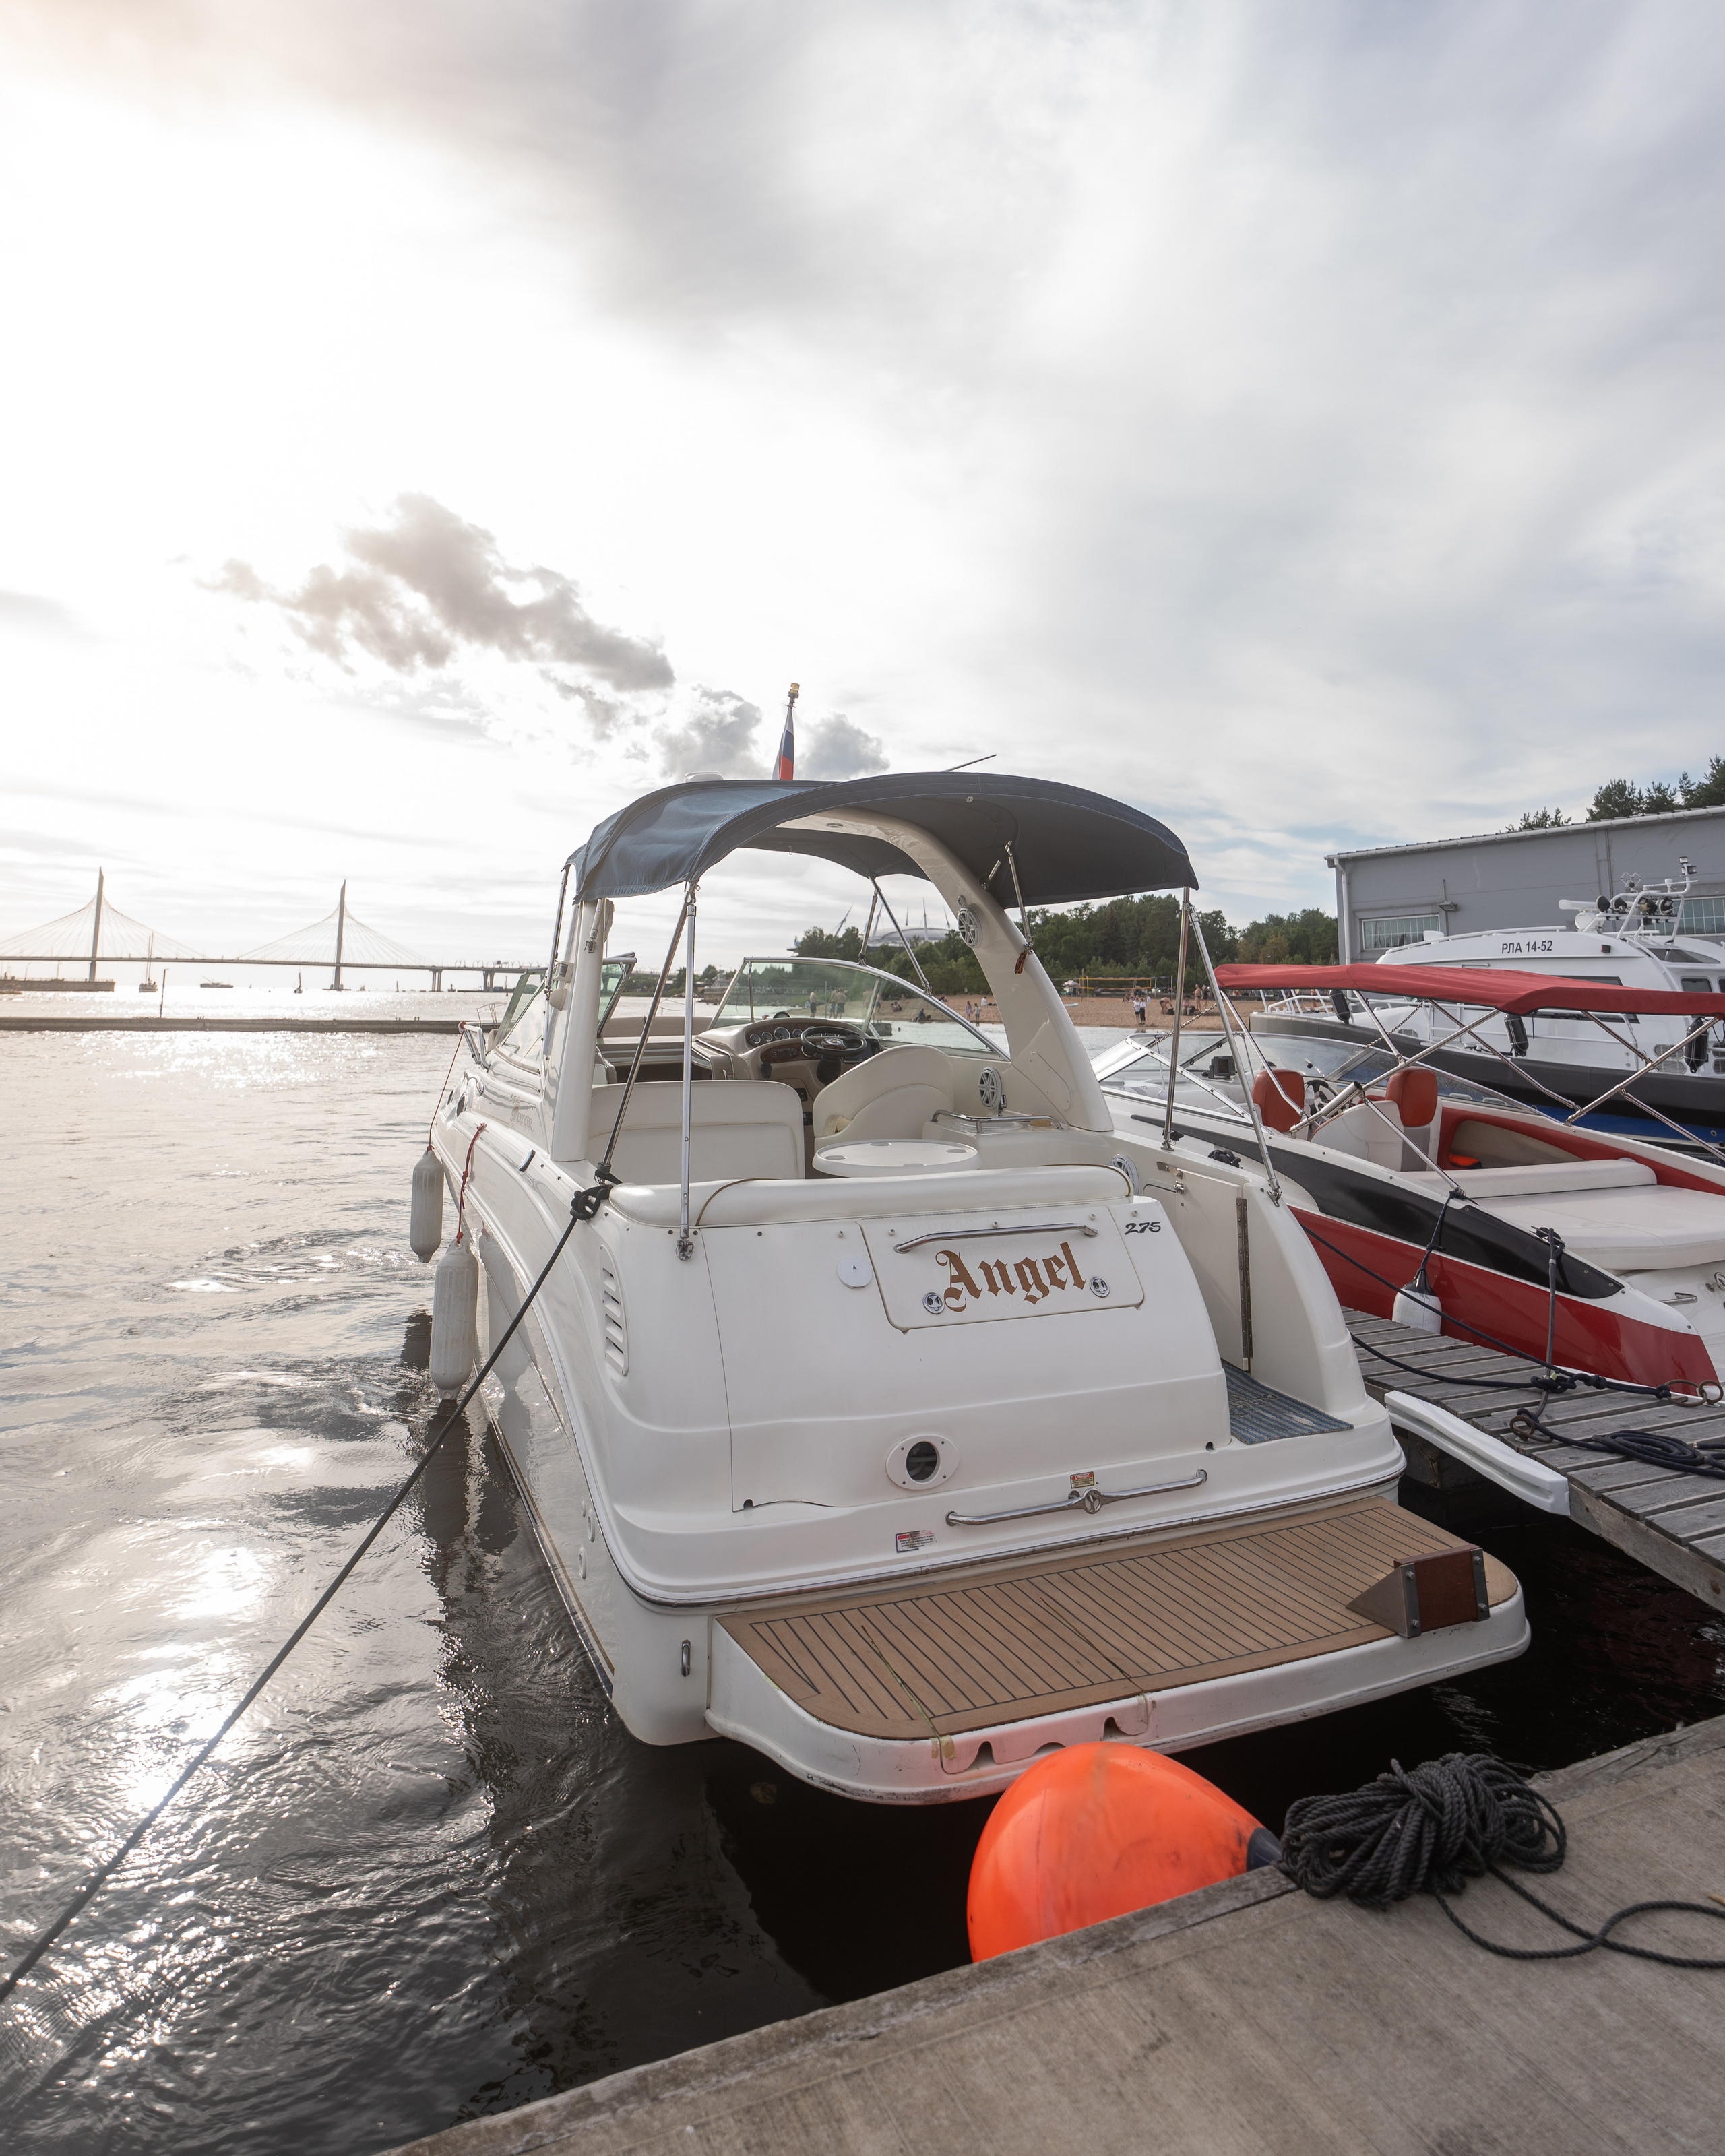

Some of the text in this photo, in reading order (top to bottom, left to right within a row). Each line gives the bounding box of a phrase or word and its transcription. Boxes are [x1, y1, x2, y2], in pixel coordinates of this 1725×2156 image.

[1501, 940, 1553, 954] РЛА 14-52
[1124, 1222, 1161, 1235] 275
[935, 1242, 1087, 1312] Angel
